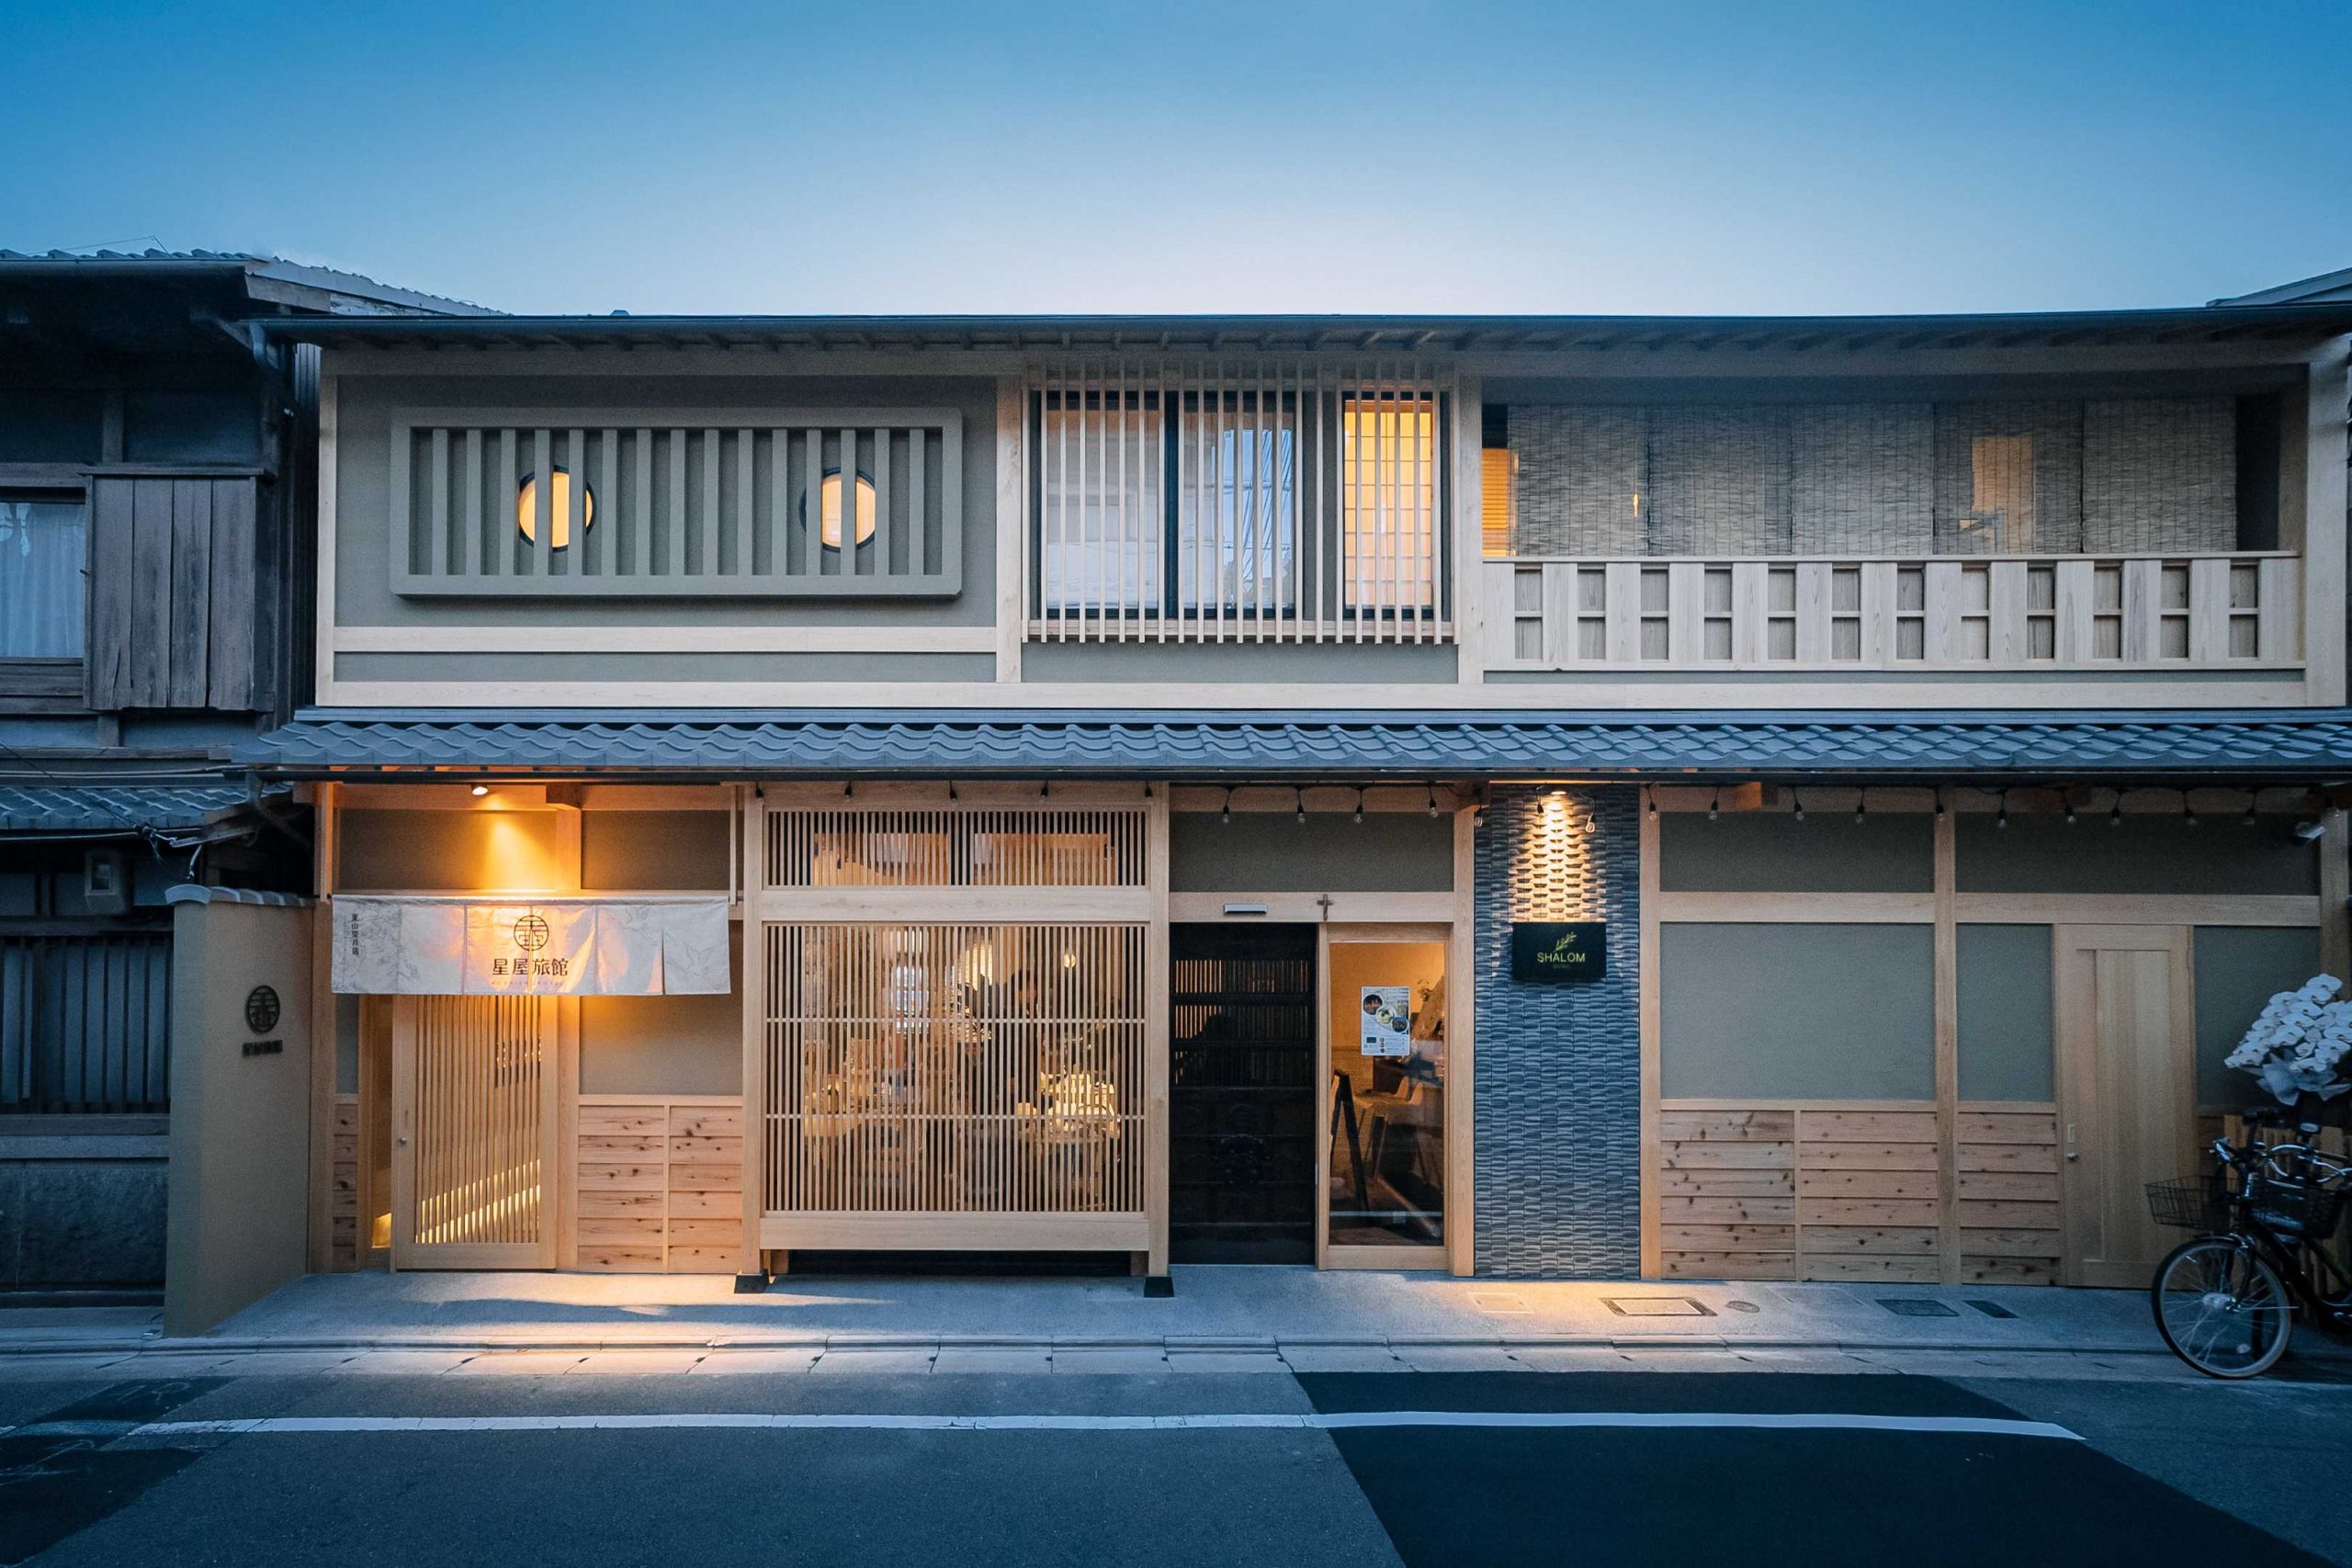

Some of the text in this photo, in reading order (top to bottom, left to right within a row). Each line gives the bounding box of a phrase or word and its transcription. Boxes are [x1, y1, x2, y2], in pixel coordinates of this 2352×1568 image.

[1537, 953, 1586, 963] SHALOM
[492, 958, 569, 976] 星屋旅館
